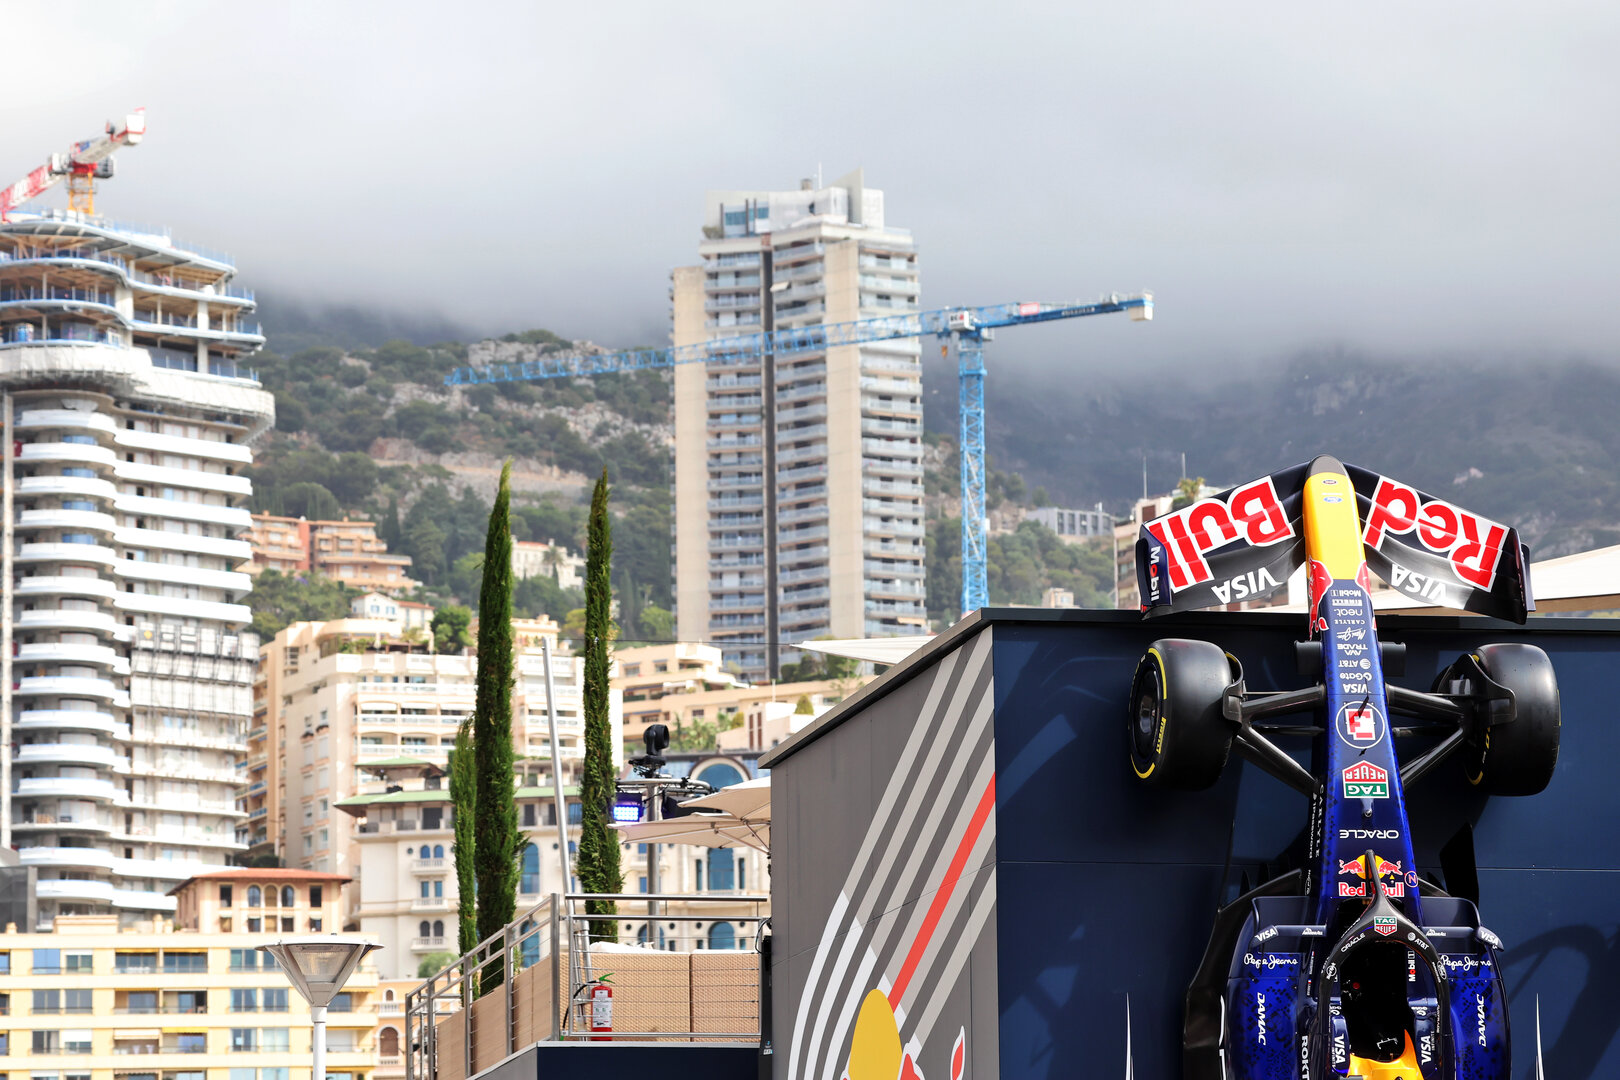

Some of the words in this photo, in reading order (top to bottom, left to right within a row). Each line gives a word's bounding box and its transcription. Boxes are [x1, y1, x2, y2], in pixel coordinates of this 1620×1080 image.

[1147, 480, 1292, 589] Bull
[1364, 480, 1506, 589] Red
[1150, 546, 1161, 602] Mobil
[1390, 563, 1449, 601] VISA
[1211, 566, 1284, 604] VISA
[1334, 608, 1362, 616] neat.
[1342, 684, 1372, 694] VISA
[1346, 765, 1385, 780] HEUER
[1348, 785, 1386, 794] TAG
[1316, 784, 1324, 858] CARLYLE
[1339, 830, 1400, 839] ORACLE
[1338, 882, 1366, 896] Red
[1380, 882, 1404, 897] Bull
[1254, 928, 1276, 942] VISA
[1341, 932, 1366, 952] ORACLE
[1414, 938, 1430, 950] AT&T
[1480, 930, 1499, 946] VISA
[1244, 953, 1268, 969] Pepe
[1268, 954, 1298, 970] Jeans
[1408, 960, 1416, 982] Mobil
[1440, 955, 1464, 970] Pepe
[1463, 956, 1492, 971] Jeans
[1257, 992, 1266, 1046] DAMAC
[1476, 994, 1487, 1048] DAMAC
[1302, 1036, 1310, 1080] ROKT
[1334, 1034, 1346, 1064] VISA
[1421, 1036, 1432, 1065] VISA
